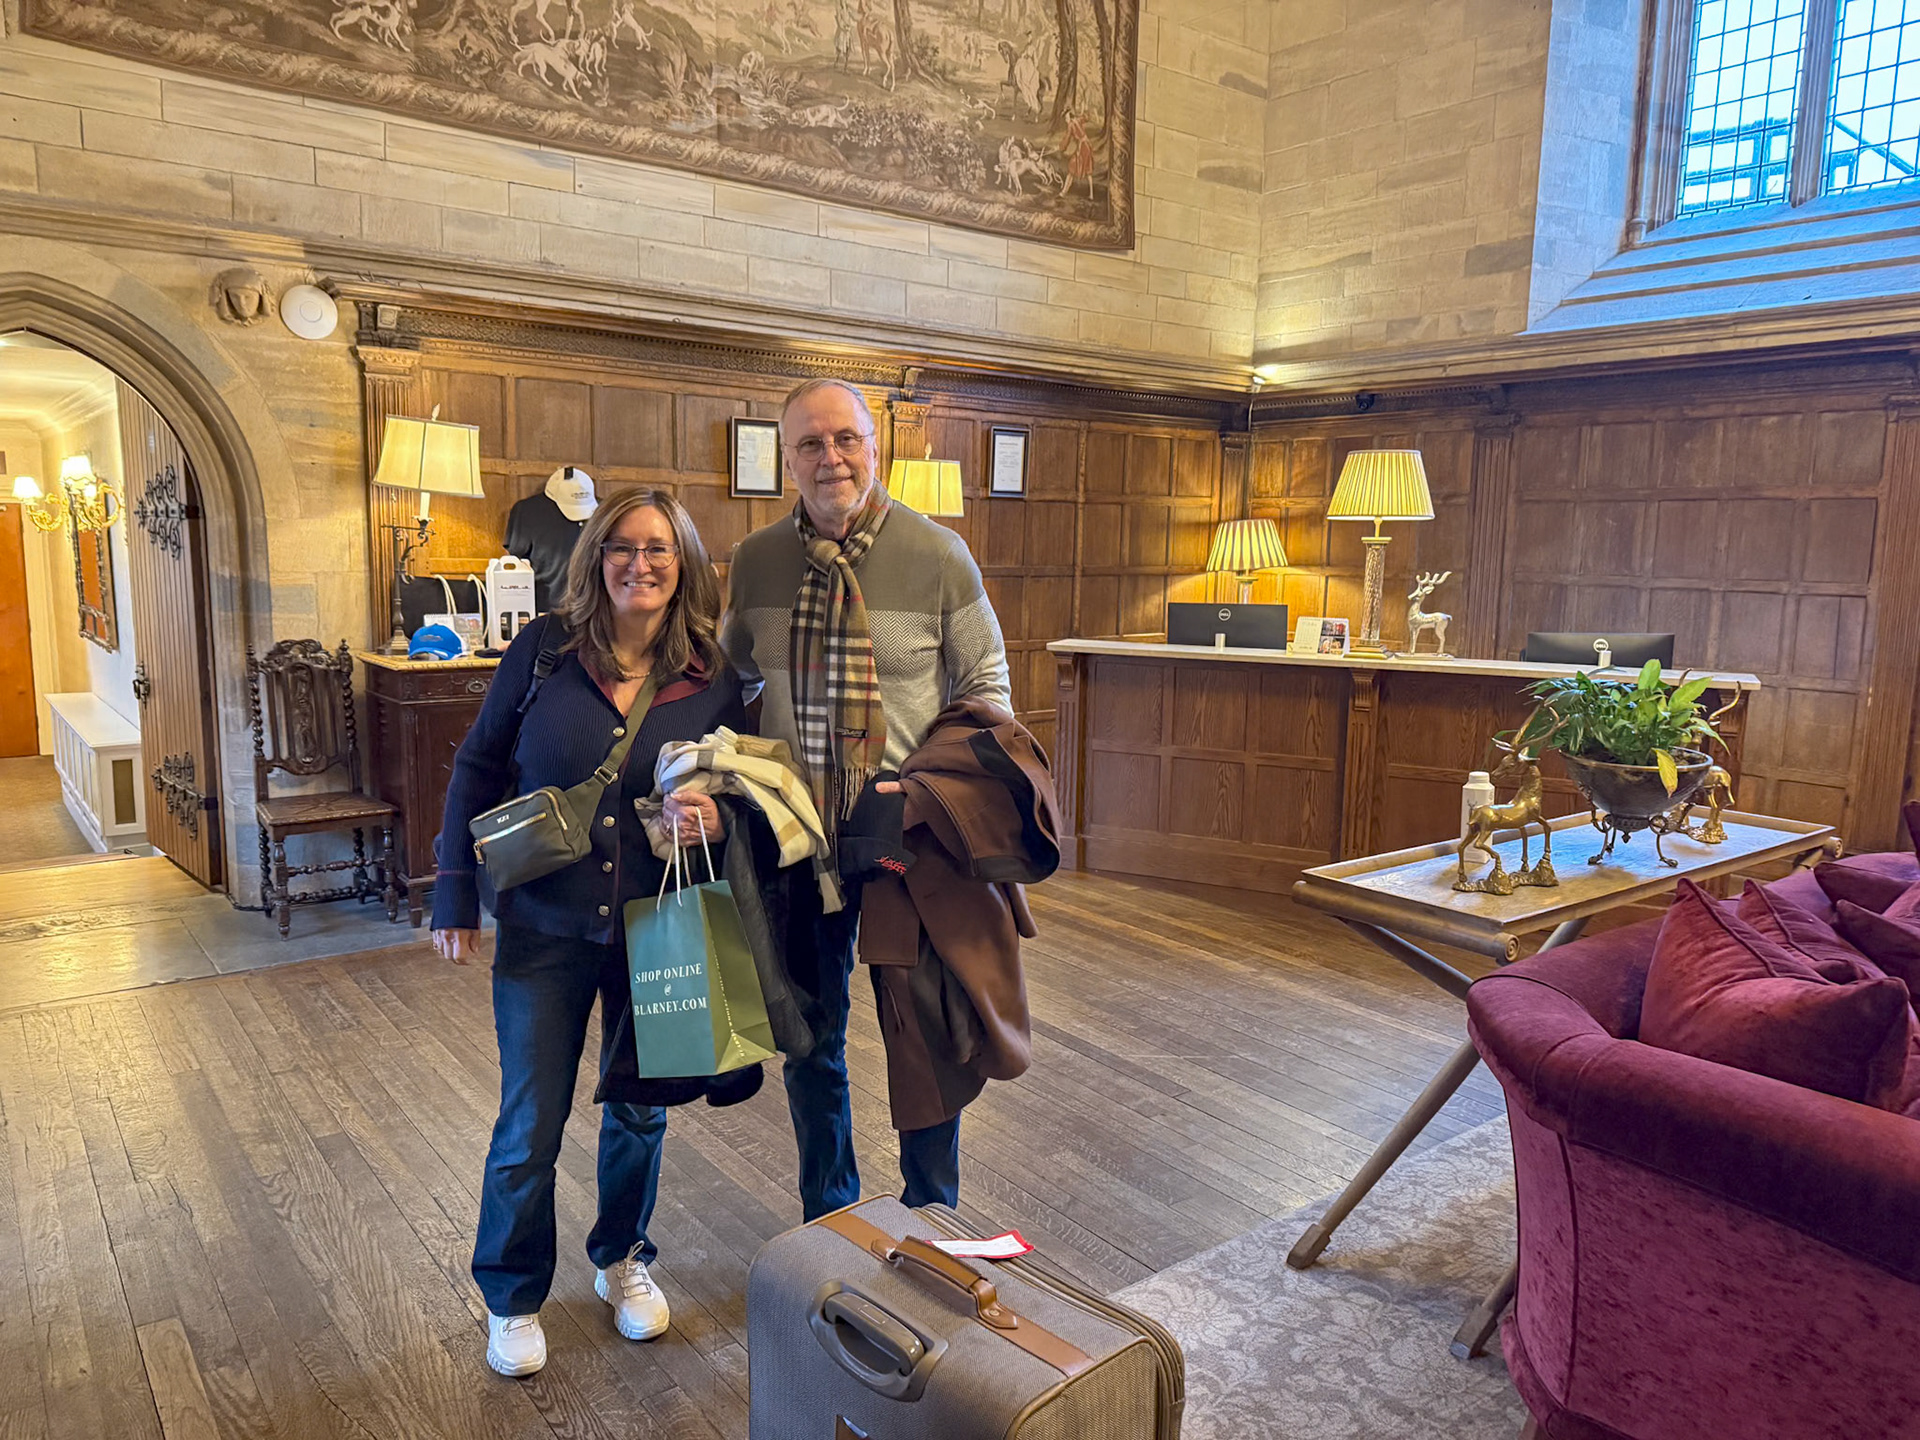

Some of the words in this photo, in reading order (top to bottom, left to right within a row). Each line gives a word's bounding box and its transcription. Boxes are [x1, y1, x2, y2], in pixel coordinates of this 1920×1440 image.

[635, 969, 661, 984] SHOP
[663, 962, 703, 980] ONLINE
[634, 996, 707, 1016] BLARNEY.COM
